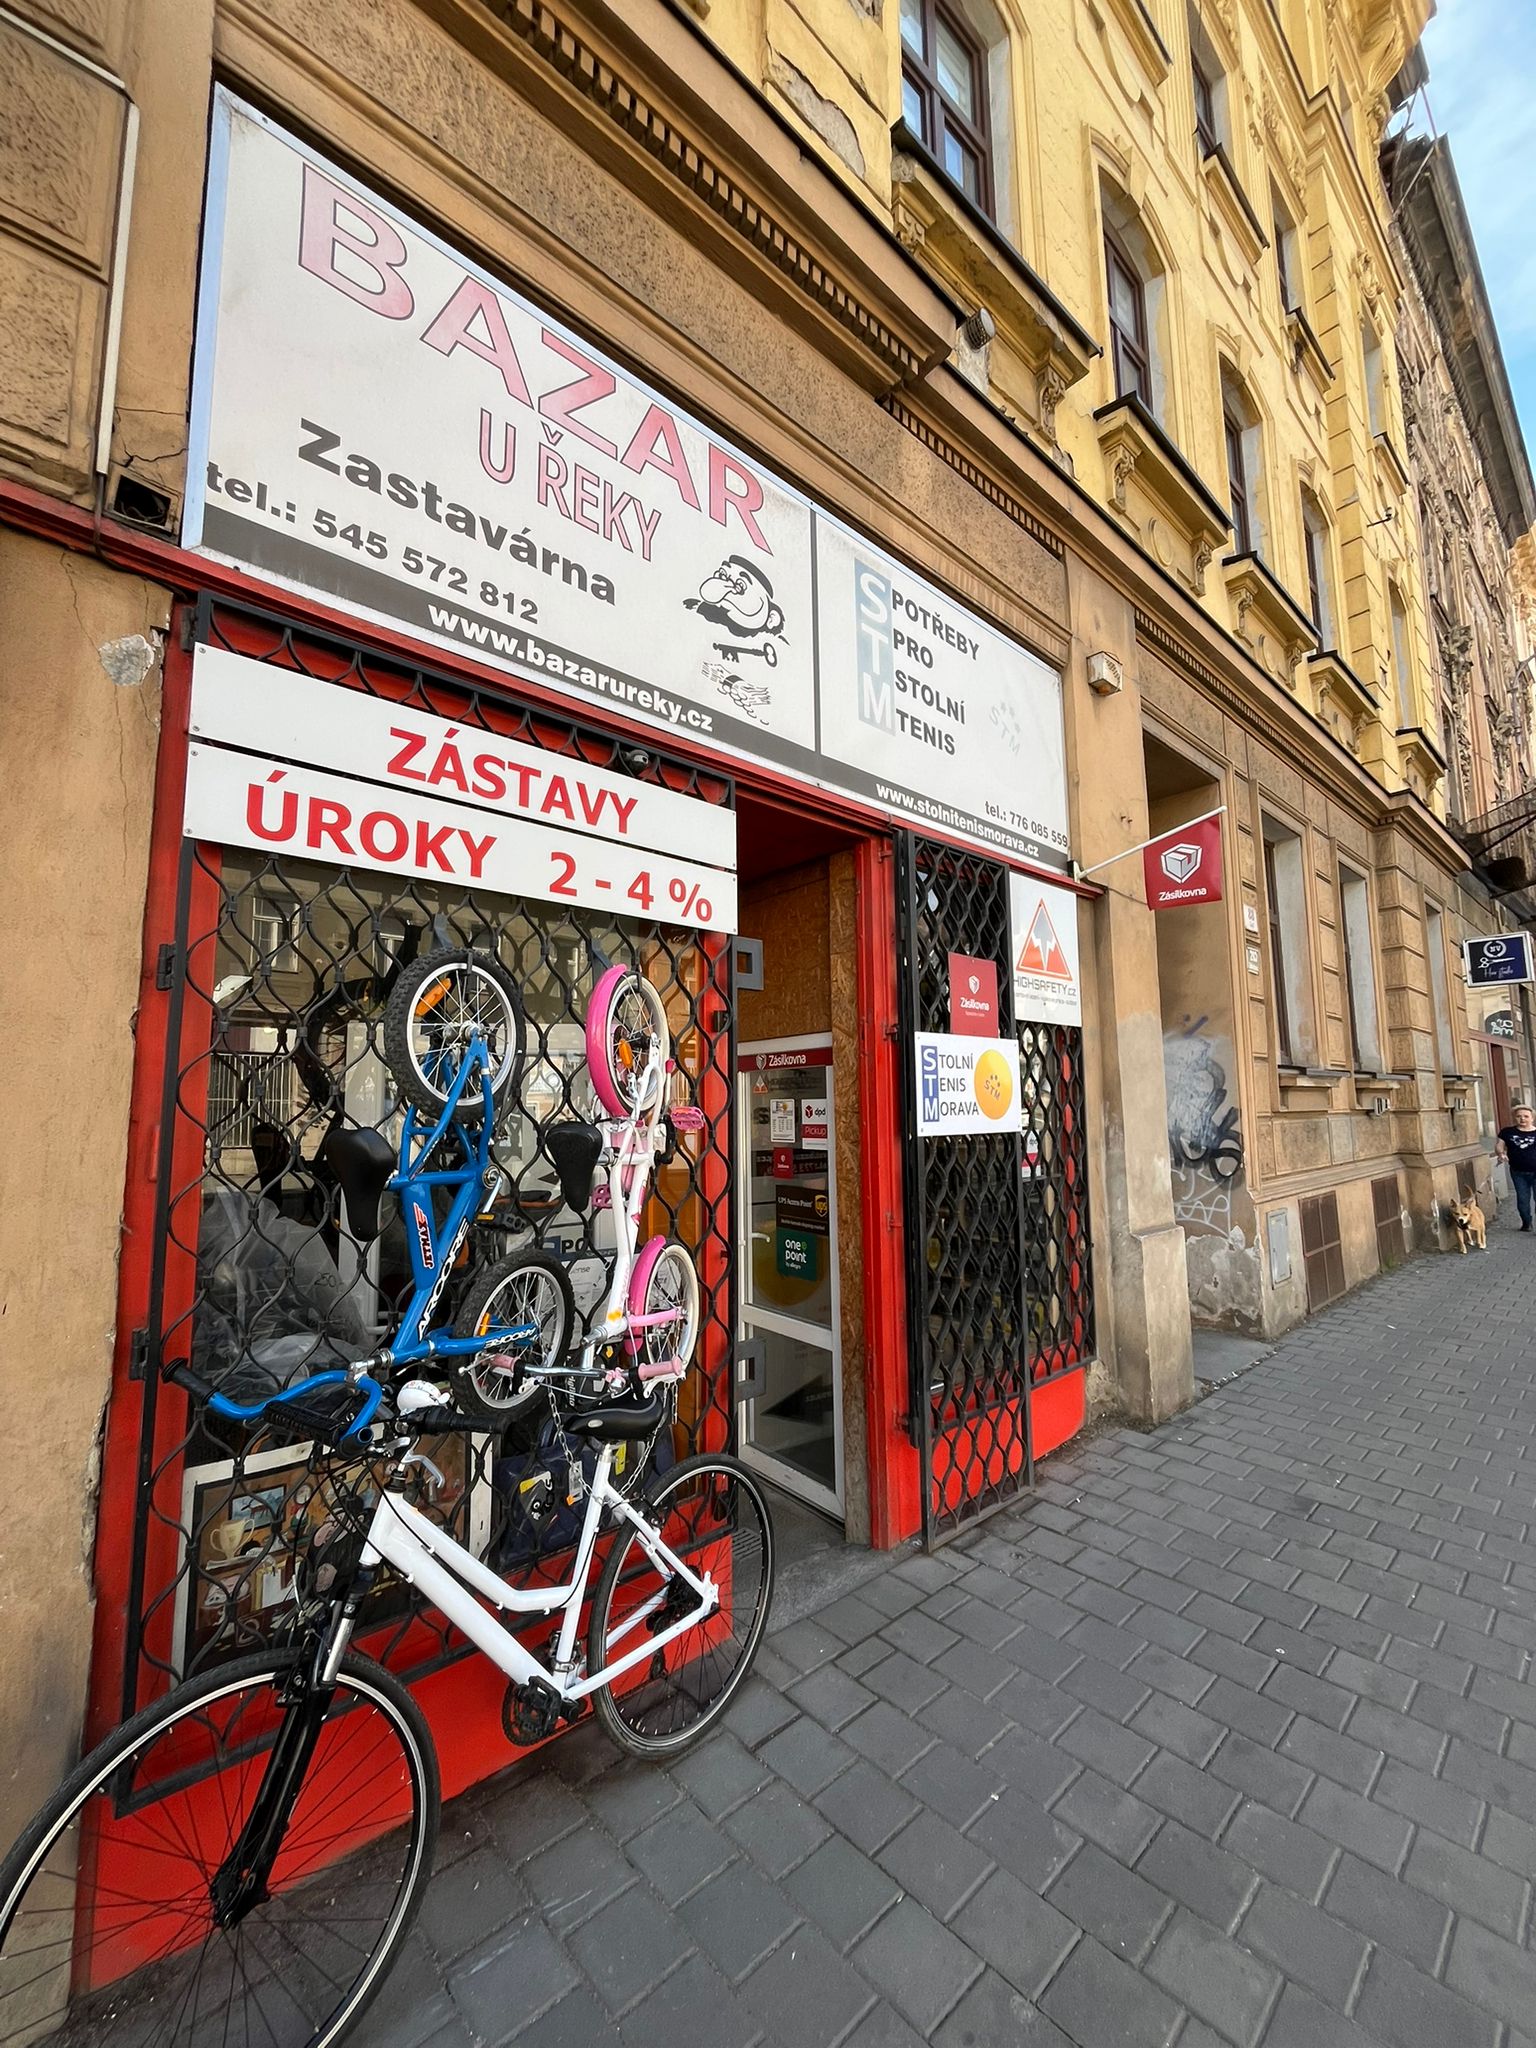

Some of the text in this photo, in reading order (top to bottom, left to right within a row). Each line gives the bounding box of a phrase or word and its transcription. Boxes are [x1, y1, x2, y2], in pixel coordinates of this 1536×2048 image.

[299, 161, 774, 555] BAZAR
[479, 408, 663, 562] U ŘEKY
[298, 418, 617, 606] Zastavárna
[206, 461, 539, 625] tel.: 545 572 812
[891, 587, 980, 662] POTŘEBY
[893, 628, 934, 670] PRO
[428, 602, 714, 733] www.bazarureky.cz
[895, 668, 966, 725] STOLNÍ
[896, 706, 956, 756] TENIS
[387, 727, 638, 834] ZÁSTAVY
[876, 783, 1039, 858] www.stolnitenismorava.cz
[985, 801, 1068, 848] tel.: 776 085 559
[246, 769, 713, 922] ÚROKY 2 - 4 %
[1158, 887, 1207, 901] Zásilkovna
[768, 1054, 807, 1067] Zásilkovna
[923, 1047, 973, 1071] STOLNÍ
[924, 1074, 966, 1097] TENIS
[925, 1097, 979, 1120] MORAVA
[814, 1107, 826, 1117] dpd
[419, 1220, 434, 1268] JETMAX
[785, 1239, 801, 1250] one
[785, 1250, 807, 1264] point
[417, 1218, 470, 1341] ARCORE
[484, 1327, 536, 1348] ARCORE
